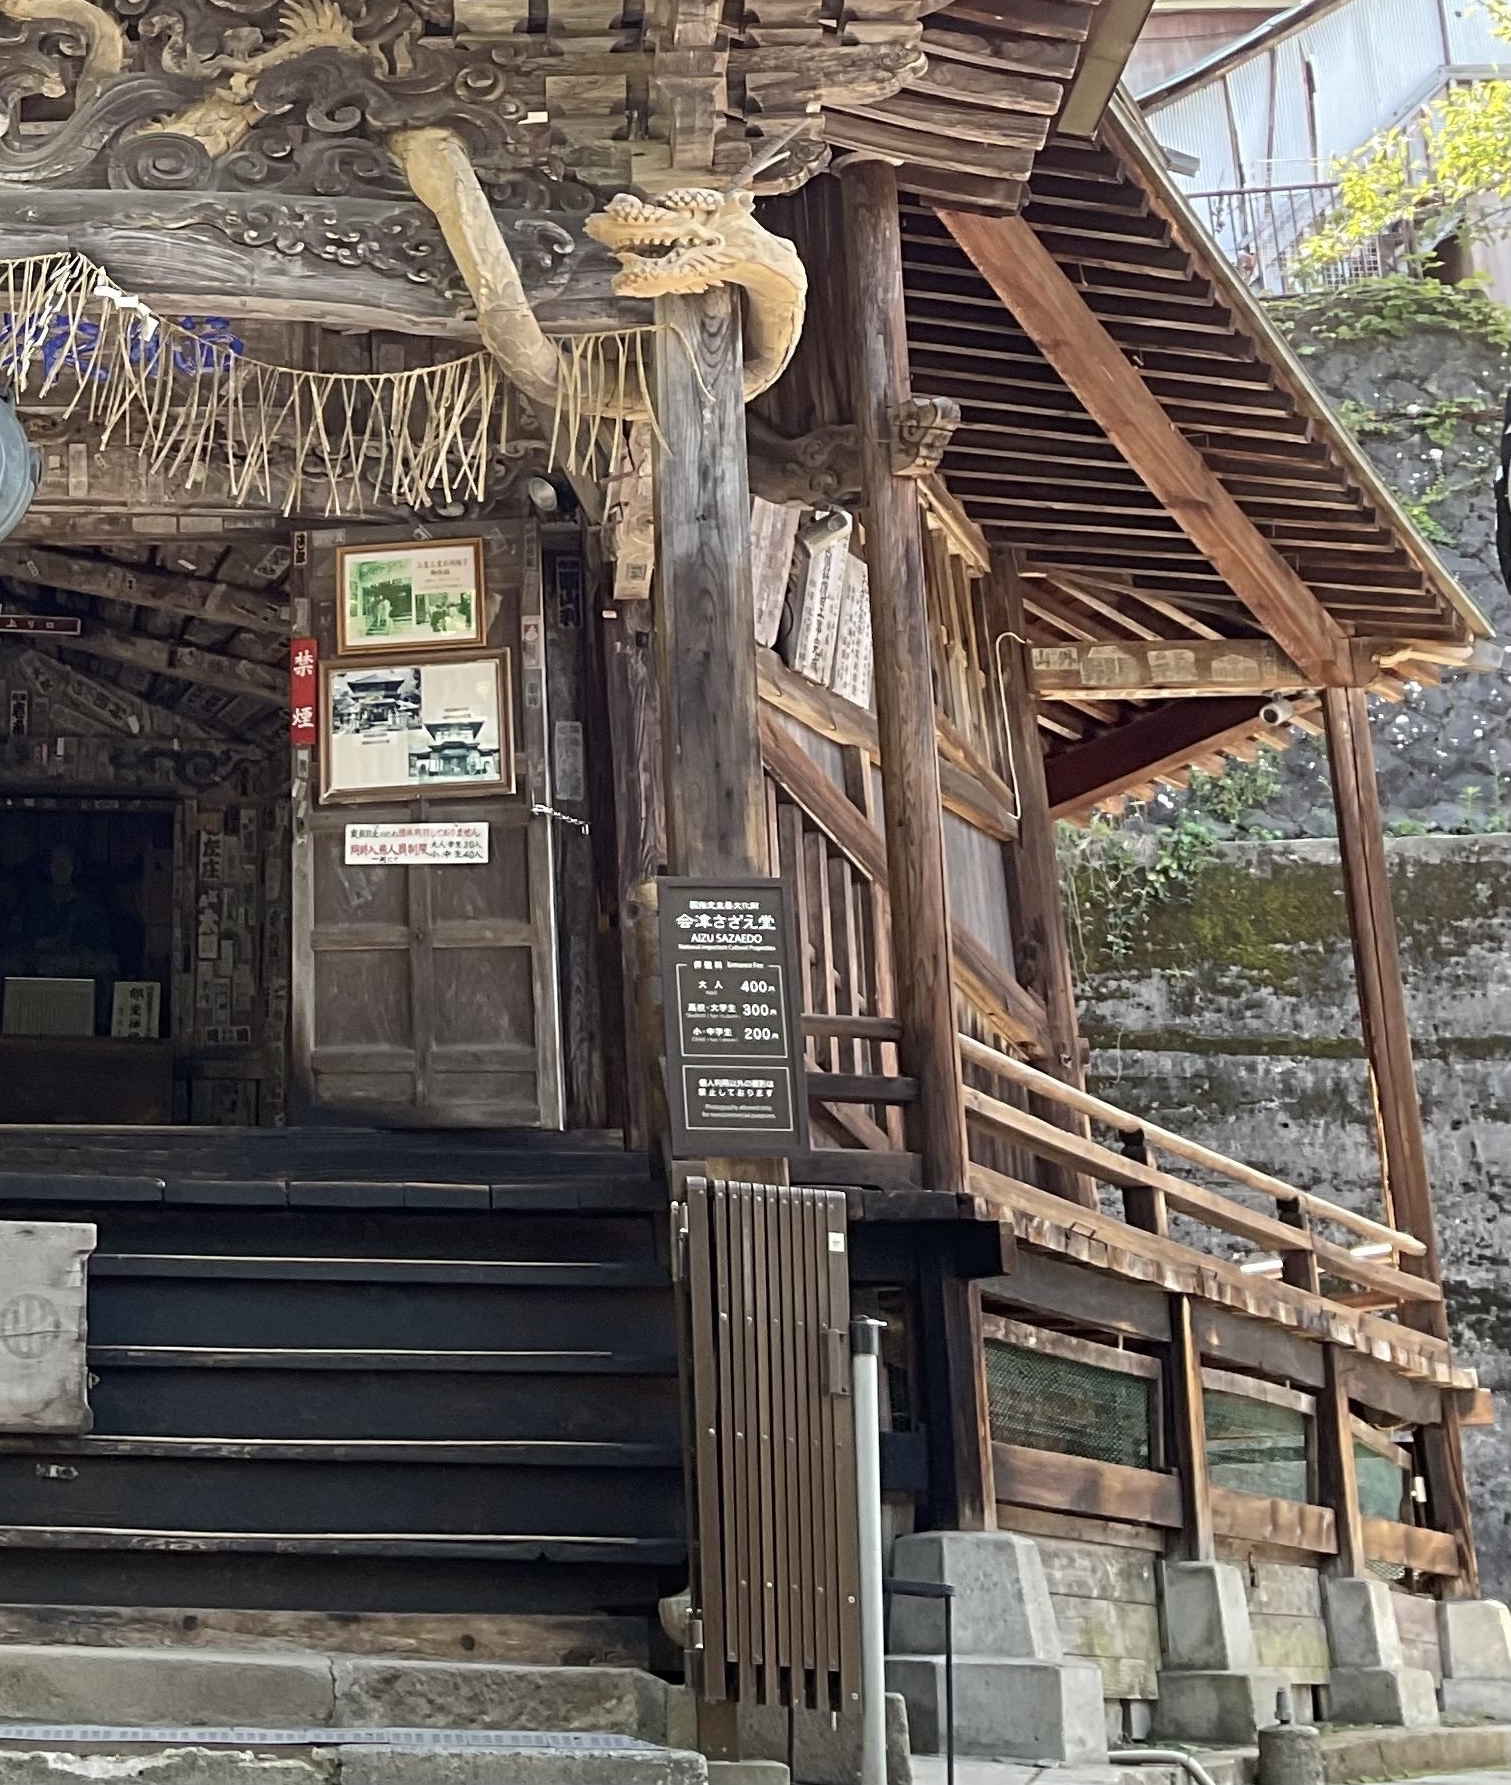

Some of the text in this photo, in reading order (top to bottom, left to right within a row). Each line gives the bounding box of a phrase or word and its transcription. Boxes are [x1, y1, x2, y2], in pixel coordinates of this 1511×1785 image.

[292, 649, 315, 729] 禁煙
[676, 913, 776, 930] 会津さざえ堂
[691, 933, 763, 943] AIZU SAZAEDO
